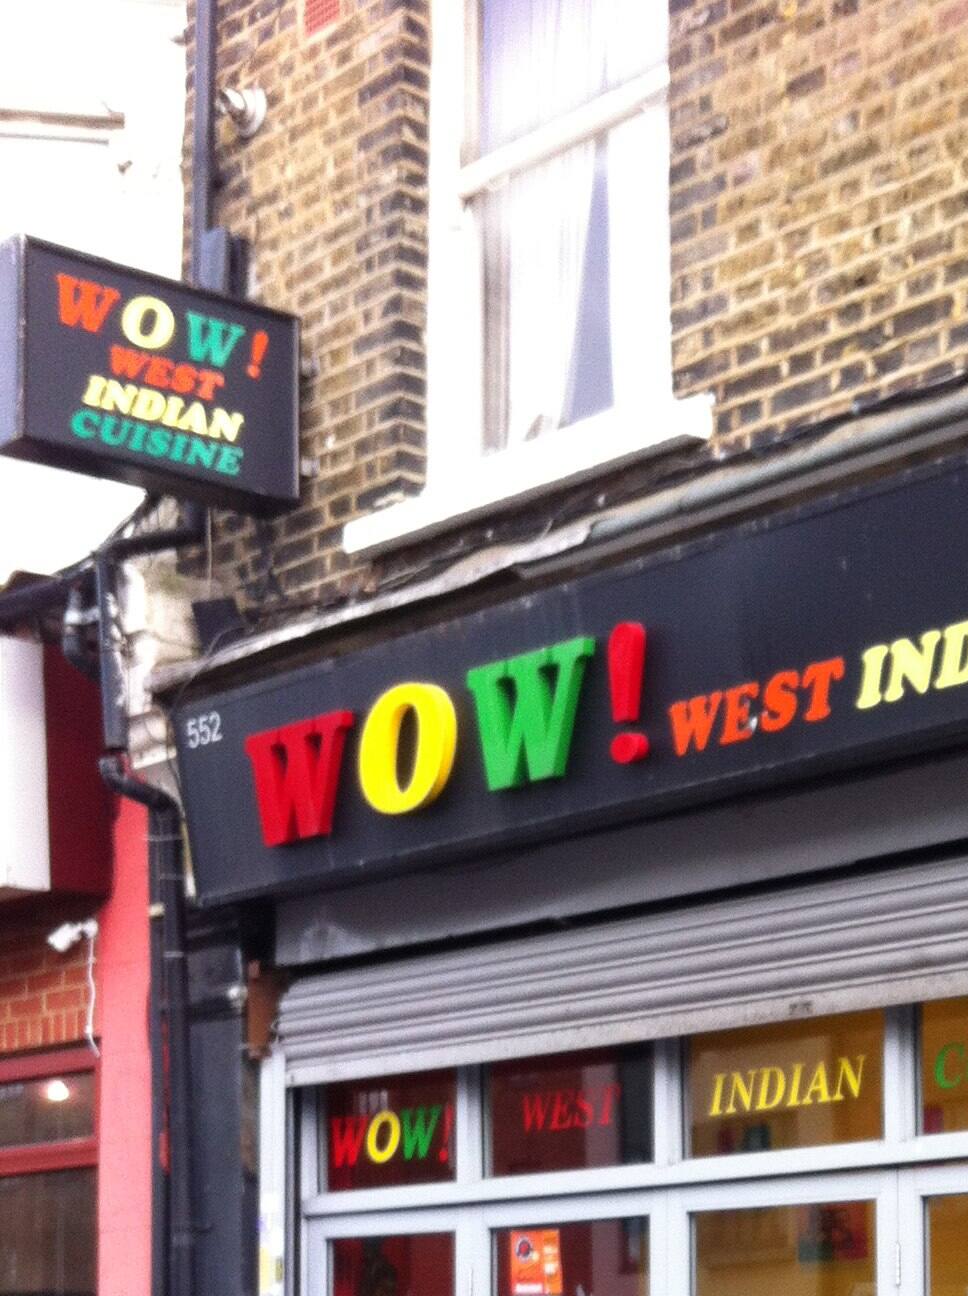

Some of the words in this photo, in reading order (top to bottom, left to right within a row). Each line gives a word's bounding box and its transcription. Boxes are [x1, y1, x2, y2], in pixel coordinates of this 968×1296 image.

[56, 272, 269, 381] WOW!
[109, 344, 225, 401] WEST
[70, 408, 244, 476] CUISINE
[82, 374, 244, 442] INDIAN
[187, 711, 222, 748] 552
[244, 621, 650, 848] WOW!
[668, 657, 845, 756] WEST
[331, 1102, 454, 1168] WOW!
[522, 1084, 621, 1133] WEST
[709, 1055, 867, 1118] INDIAN
